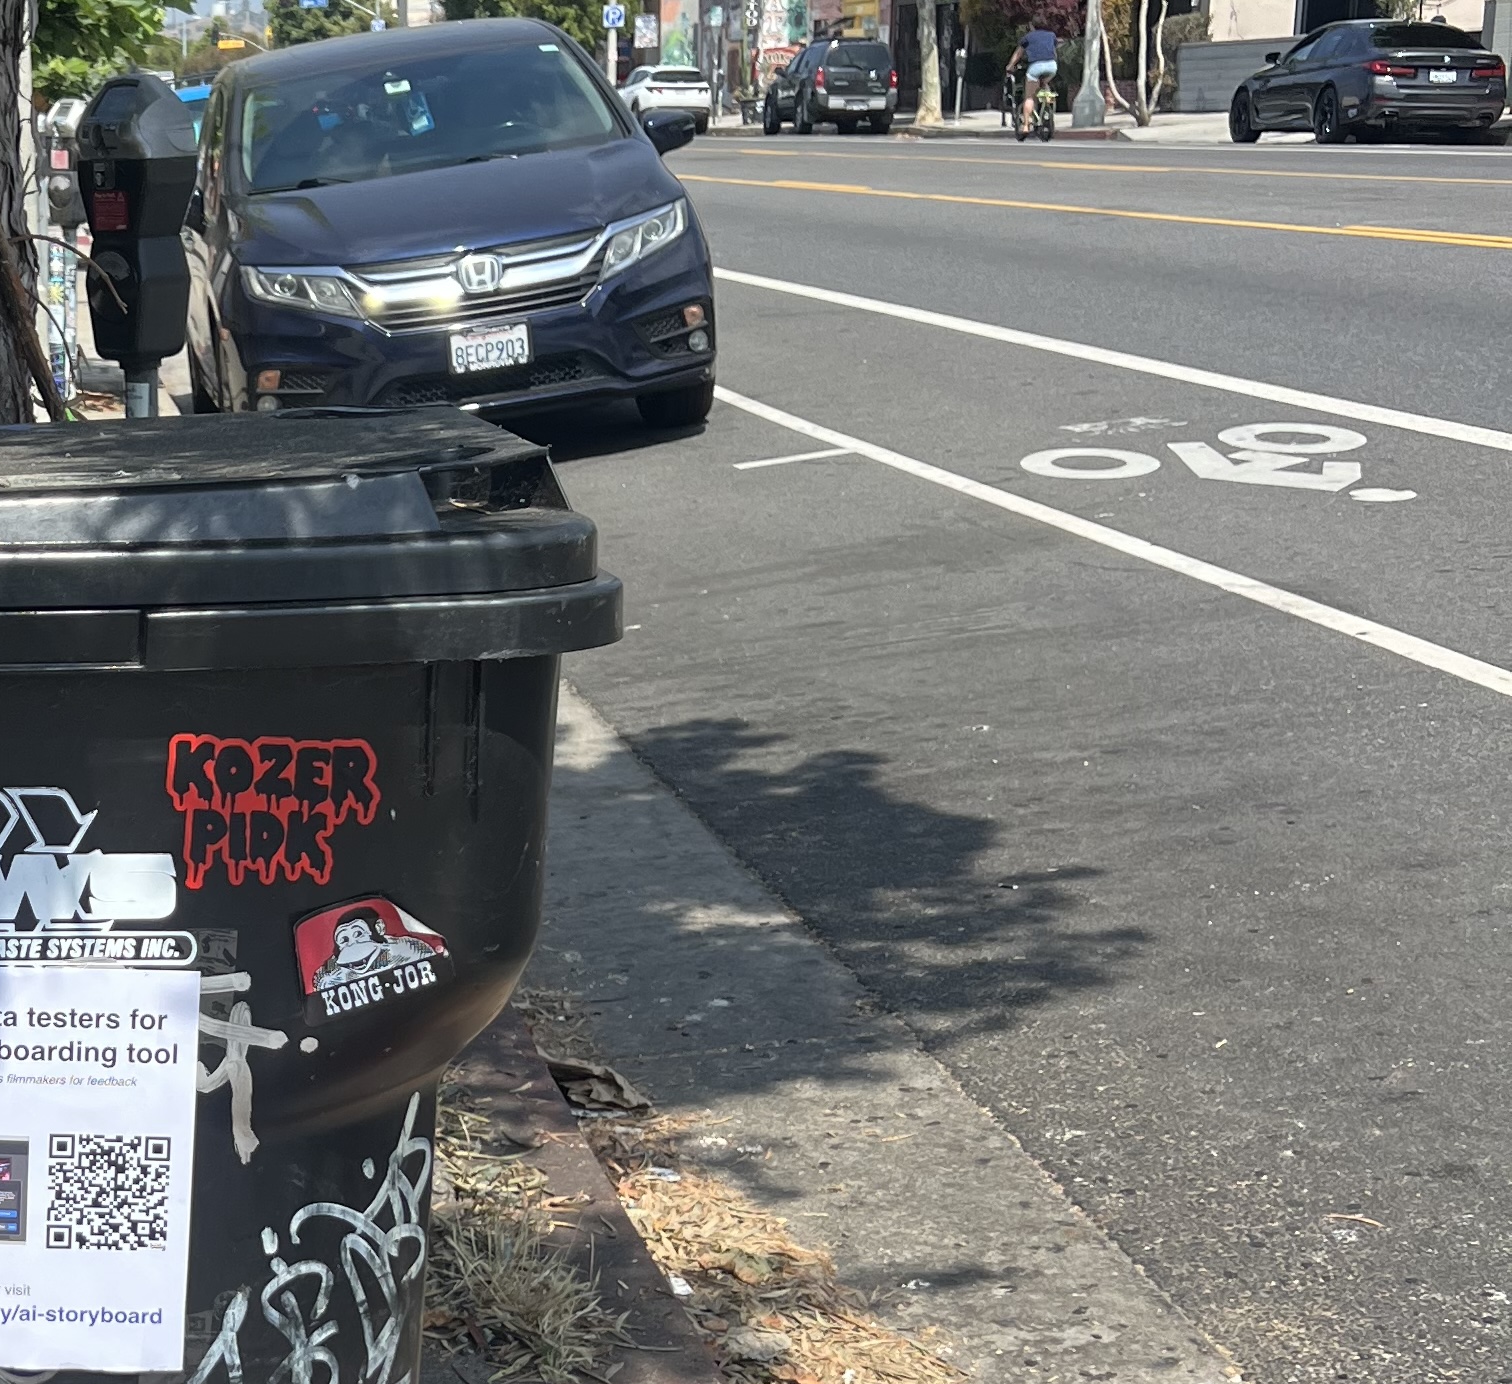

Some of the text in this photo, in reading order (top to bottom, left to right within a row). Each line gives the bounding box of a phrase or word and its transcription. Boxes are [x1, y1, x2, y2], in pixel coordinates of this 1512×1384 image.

[454, 337, 526, 366] 8ECP903
[166, 733, 382, 825] KOZER
[46, 937, 136, 959] SYSTEMS
[140, 938, 181, 959] INC.
[27, 1007, 121, 1030] testers
[130, 1009, 169, 1031] for
[126, 1043, 178, 1065] tool
[6, 1073, 67, 1086] filmmakers
[69, 1075, 85, 1087] for
[86, 1075, 138, 1088] feedback
[4, 1284, 32, 1297] visit
